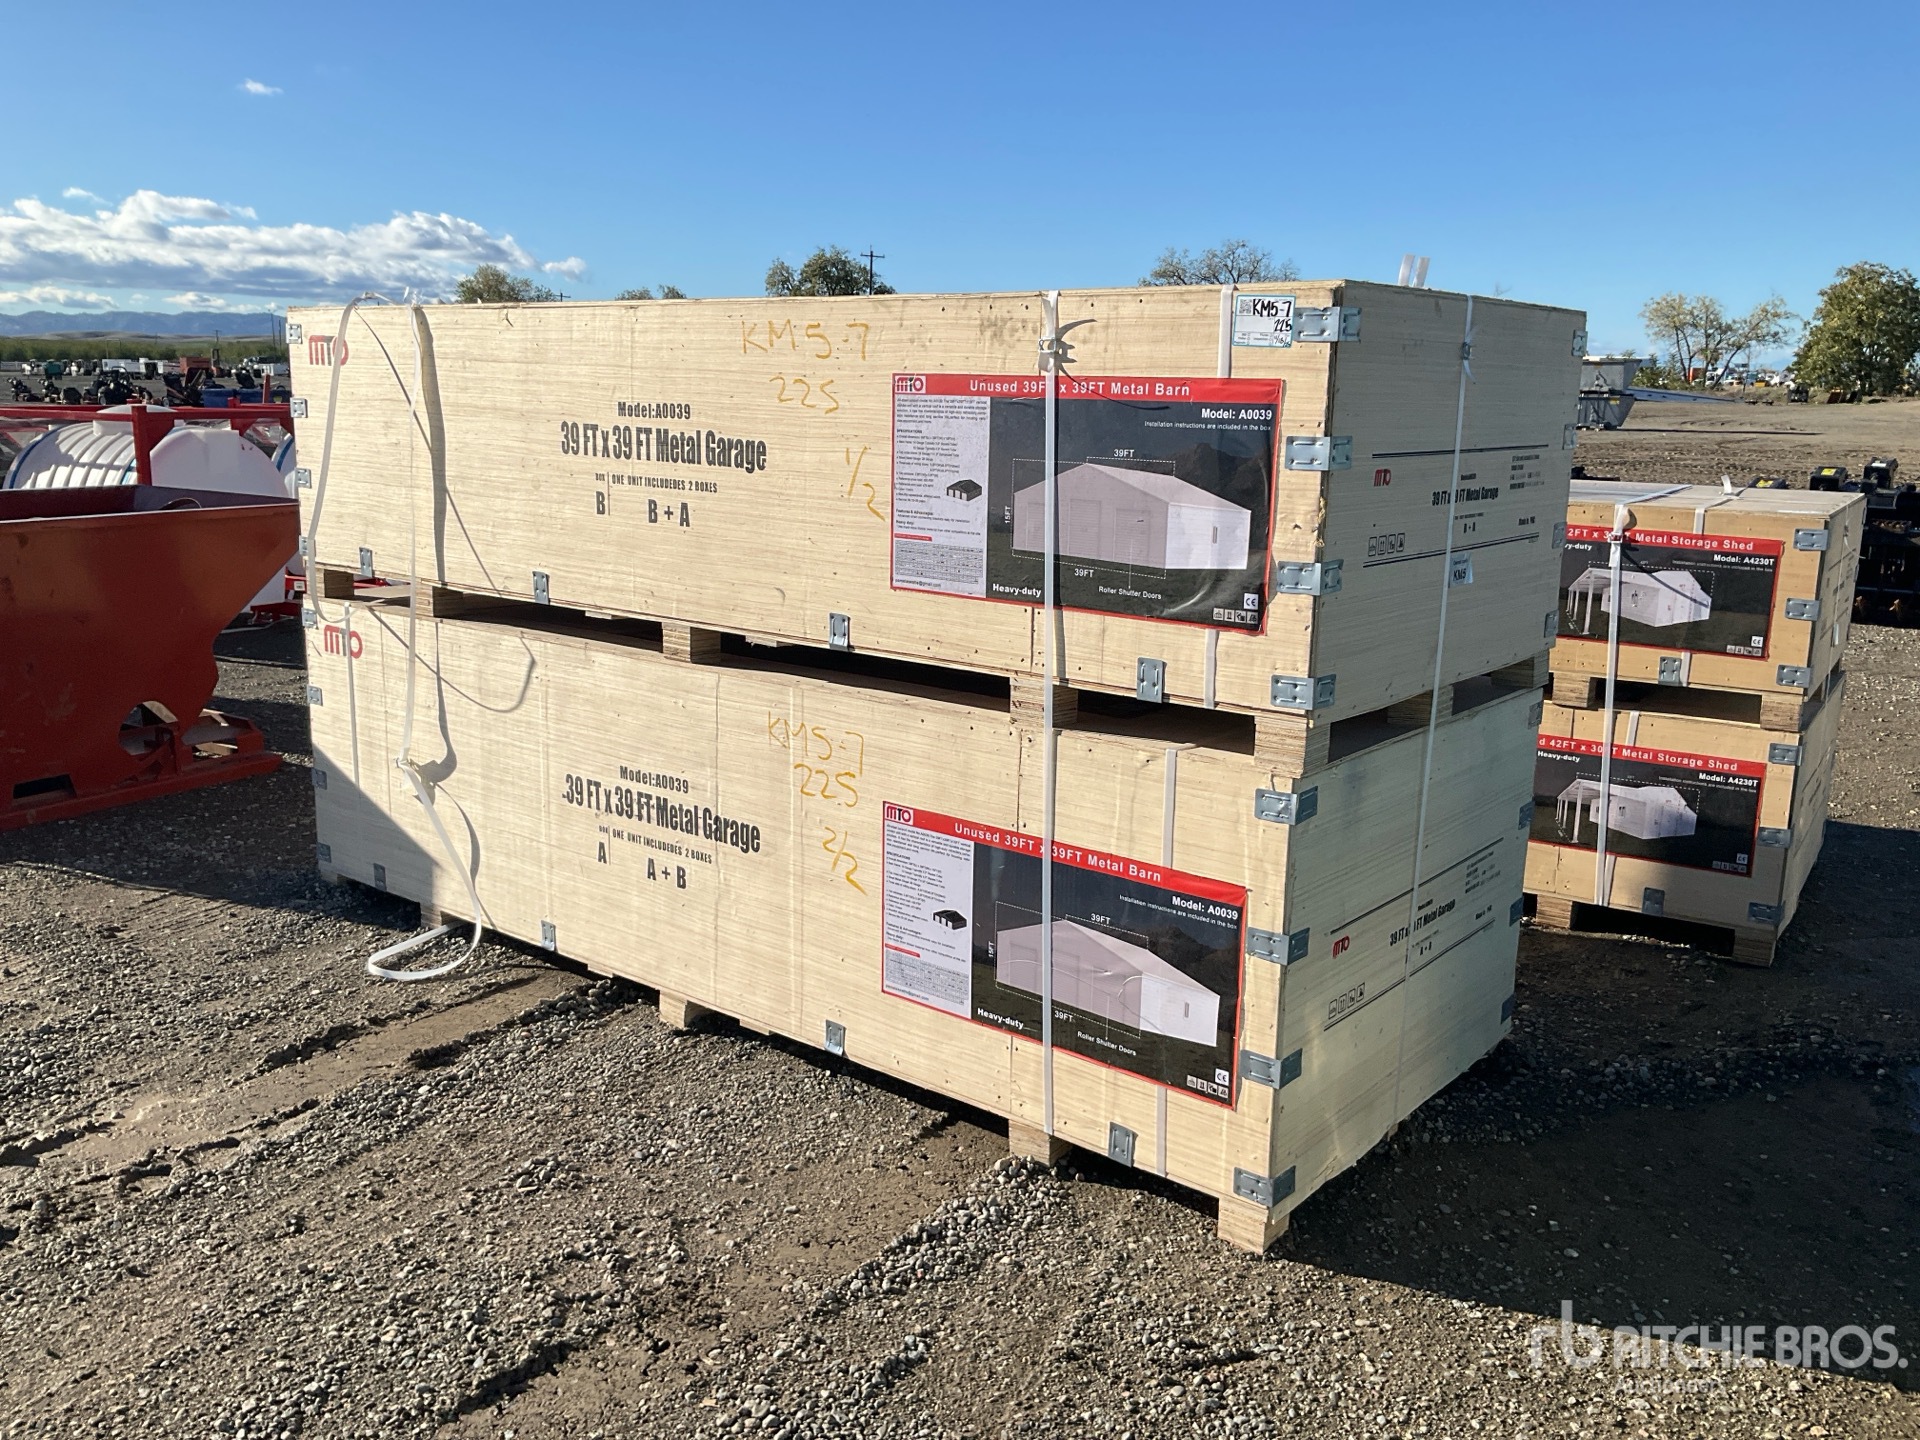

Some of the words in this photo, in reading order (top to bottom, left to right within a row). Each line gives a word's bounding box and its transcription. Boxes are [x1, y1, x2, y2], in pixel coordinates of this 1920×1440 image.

[1252, 298, 1292, 318] KM5-7
[769, 376, 839, 414] 225
[969, 379, 1018, 393] Unused
[1022, 381, 1046, 393] 39F
[1060, 384, 1067, 393] x
[1072, 381, 1106, 395] 39FT
[1111, 382, 1150, 395] Metal
[1155, 383, 1190, 397] Barn
[617, 401, 691, 420] Model:A0039
[1201, 408, 1236, 420] Model:
[1238, 409, 1273, 421] A0039
[561, 420, 580, 456] 39
[582, 423, 599, 457] FT
[601, 430, 610, 458] x
[612, 425, 632, 460] 39
[635, 427, 652, 462] FT
[655, 428, 702, 465] Metal
[705, 430, 767, 474] Garage
[1113, 449, 1135, 458] 39FT
[611, 474, 625, 485] ONE
[627, 476, 643, 487] UNIT
[695, 481, 718, 493] BOXES
[595, 491, 606, 515] B
[648, 499, 658, 524] B
[679, 502, 690, 527] A
[1004, 505, 1012, 524] 15FT
[1567, 528, 1588, 538] 2FT
[1635, 534, 1667, 544] Metal
[1671, 535, 1718, 549] Storage
[1723, 540, 1754, 551] Shed
[1713, 554, 1741, 563] Model:
[1743, 557, 1775, 566] A4230T
[1074, 568, 1094, 578] 39FT
[992, 583, 1042, 598] Heavy-duty
[1098, 586, 1116, 595] Roller
[1118, 587, 1141, 598] Shutter
[1142, 589, 1162, 600] Doors
[324, 625, 363, 659] MTO
[1537, 750, 1580, 763] Heavy-duty
[1549, 739, 1576, 750] 42FT
[1591, 745, 1618, 755] 30T
[1622, 748, 1653, 760] Metal
[1657, 753, 1703, 767] Storage
[1708, 759, 1738, 771] Shed
[619, 765, 689, 794] Model:A0039
[794, 763, 858, 808] 225
[1699, 772, 1726, 783] Model:
[1728, 777, 1758, 787] A4230T
[565, 774, 584, 806] 39
[586, 778, 601, 811] FT
[604, 788, 612, 814] x
[614, 785, 634, 819] 39
[636, 791, 653, 824] FT
[655, 795, 699, 836] Metal
[702, 807, 761, 854] Garage
[886, 805, 911, 822] MTO
[597, 842, 607, 864] A
[612, 828, 624, 840] ONE
[627, 832, 642, 845] UNIT
[690, 849, 712, 864] BOXES
[955, 822, 1000, 844] Unused
[1004, 834, 1035, 851] 39FT
[1052, 846, 1082, 862] 39FT
[1087, 855, 1123, 873] Metal
[1129, 864, 1161, 882] Barn
[647, 857, 656, 881] A
[677, 865, 687, 889] B
[1172, 895, 1205, 912] Model:
[1207, 905, 1238, 920] A0039
[1090, 913, 1111, 925] 39FT
[1332, 935, 1350, 959] MTO
[977, 1007, 1024, 1030] Heavy-duty
[1054, 1010, 1073, 1022] 39FT
[1077, 1031, 1095, 1044] Roller
[1096, 1036, 1118, 1051] Shutter
[1118, 1044, 1137, 1056] Doors
